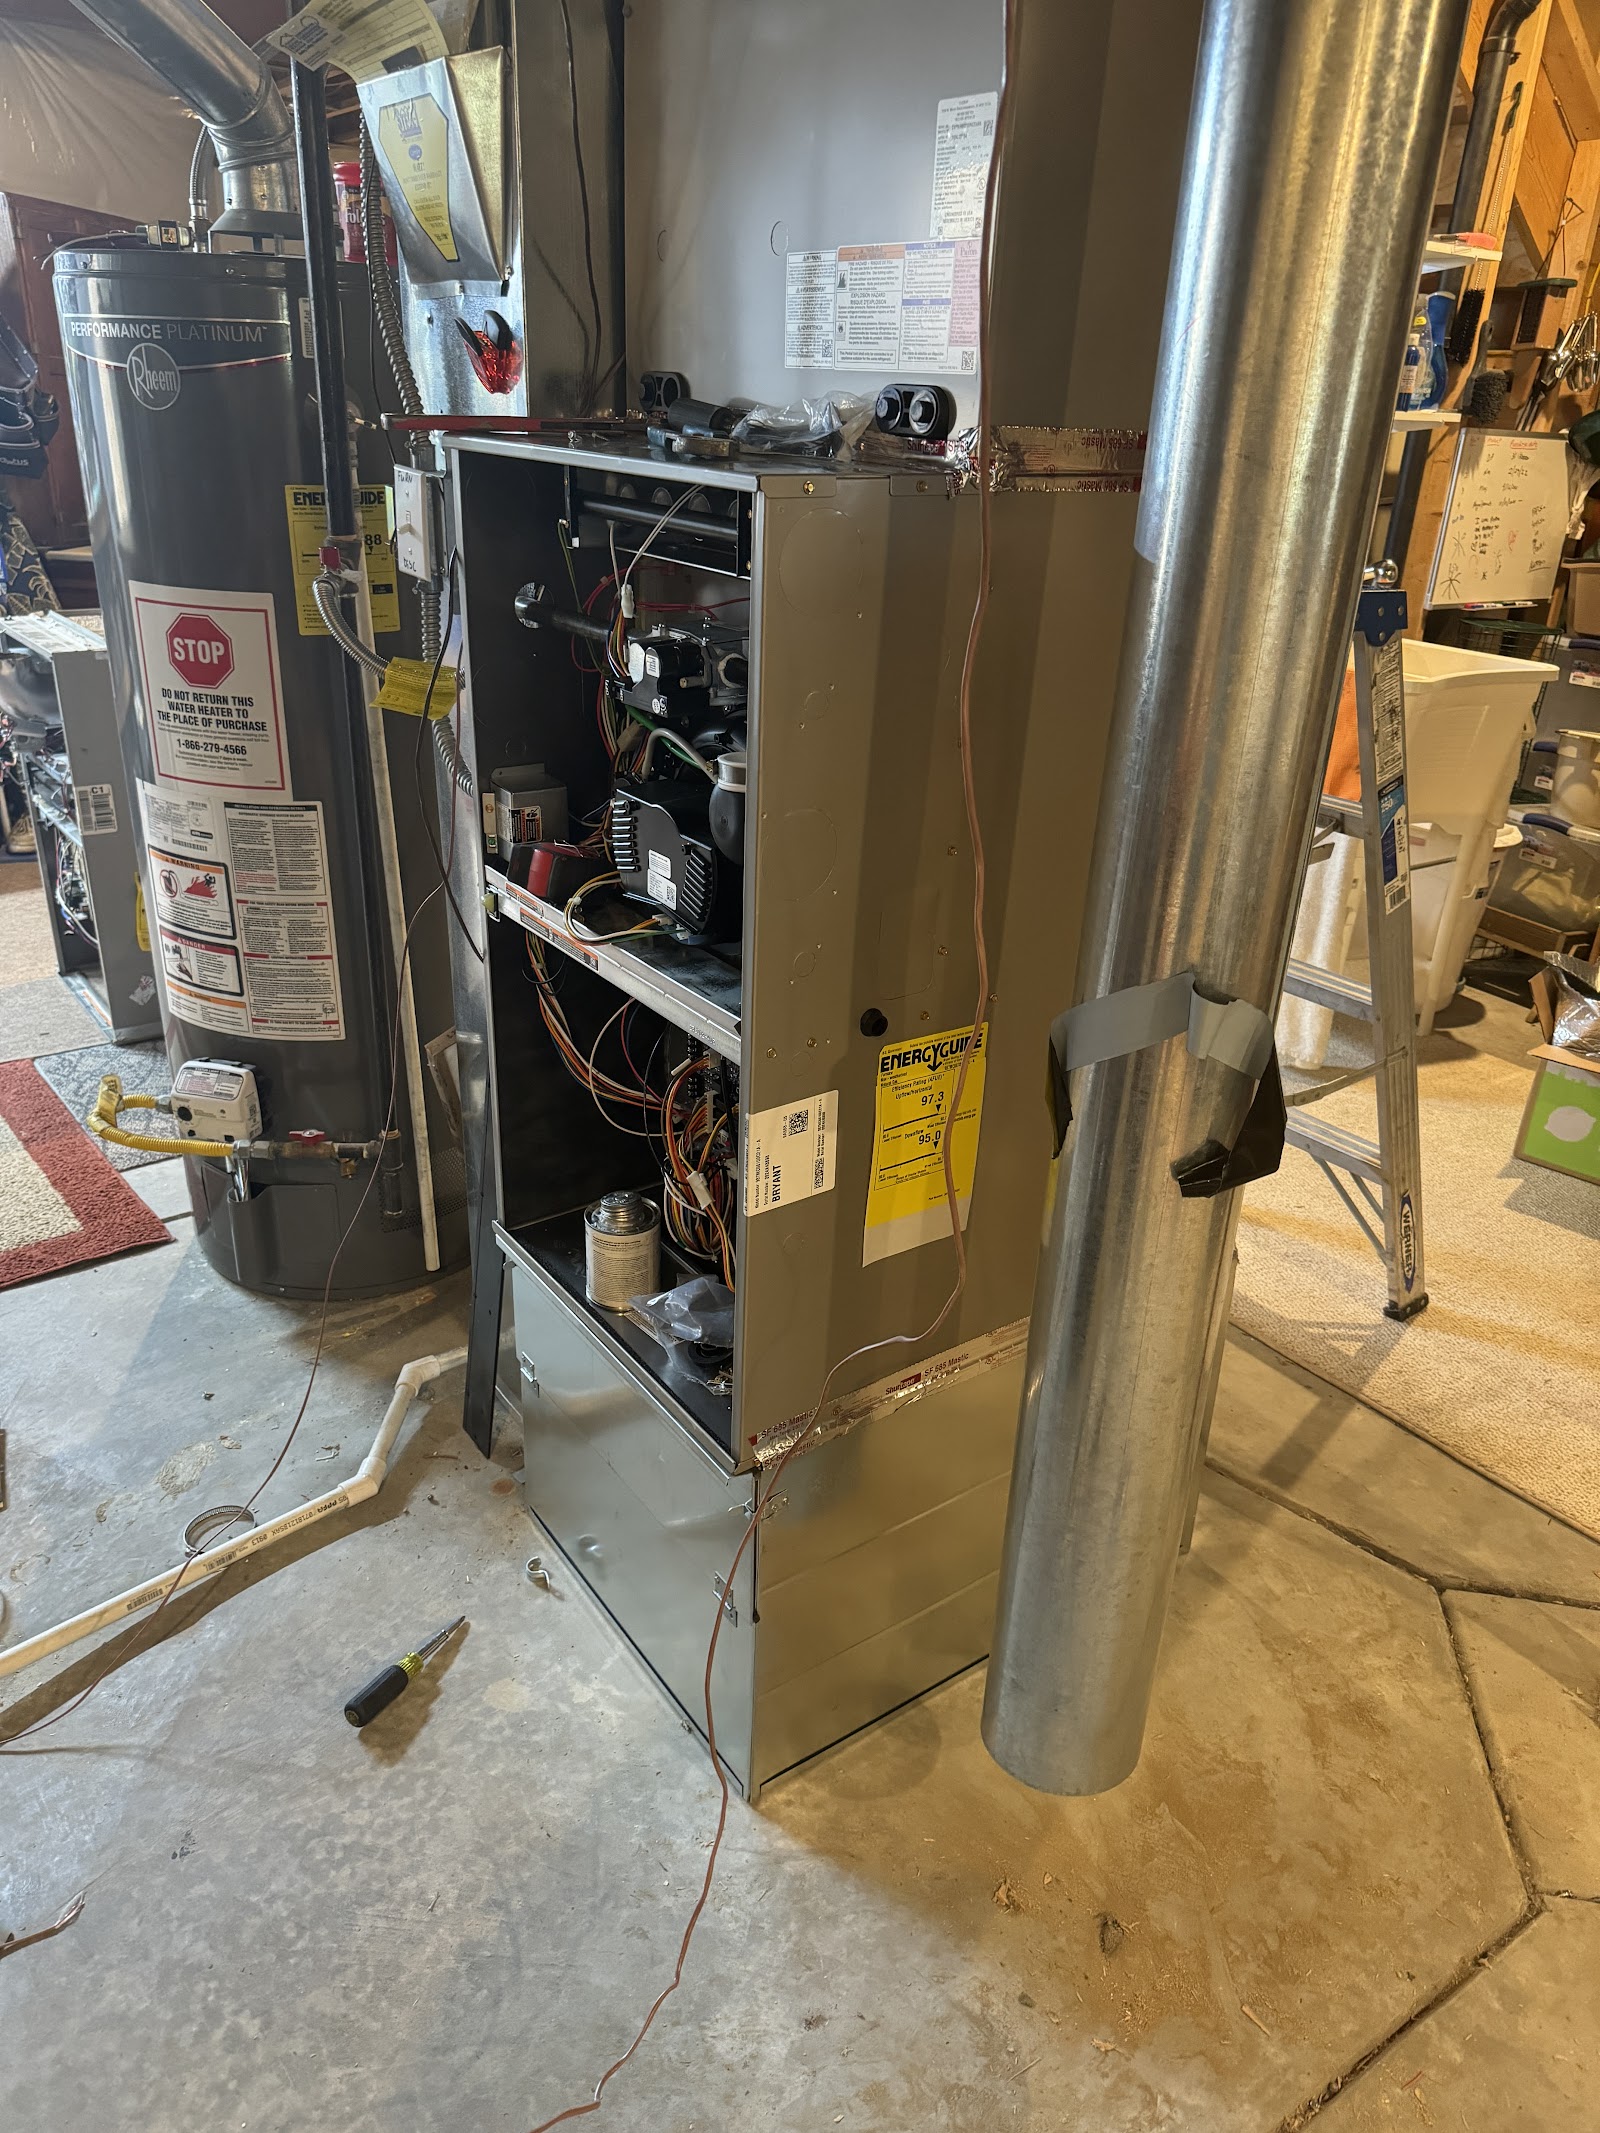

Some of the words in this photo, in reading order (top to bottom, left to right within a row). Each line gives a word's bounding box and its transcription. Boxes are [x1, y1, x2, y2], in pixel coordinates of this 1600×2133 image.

[71, 321, 162, 340] PERFORMANCE
[132, 346, 178, 400] Rheem
[172, 637, 225, 664] STOP
[162, 688, 172, 699] DO
[174, 690, 190, 702] NOT
[193, 692, 228, 705] RETURN
[232, 696, 254, 707] THIS
[168, 701, 196, 714] WATER
[198, 704, 233, 718] HEATER
[236, 708, 248, 719] TO
[157, 710, 171, 722] THE
[173, 713, 200, 726] PLACE
[202, 717, 213, 728] OF
[216, 718, 268, 732] PURCHASE
[177, 738, 247, 756] 1-866-279-4566
[92, 786, 104, 794] C1
[921, 1092, 944, 1106] 97.3
[904, 1129, 924, 1139] Downflow
[918, 1130, 940, 1144] 95.0
[772, 1165, 782, 1202] BRYANT
[1402, 1210, 1413, 1274] WERNER
[924, 1367, 934, 1376] SF
[948, 1352, 969, 1367] Mastic
[761, 1428, 772, 1438] SF
[788, 1410, 814, 1426] Mastic
